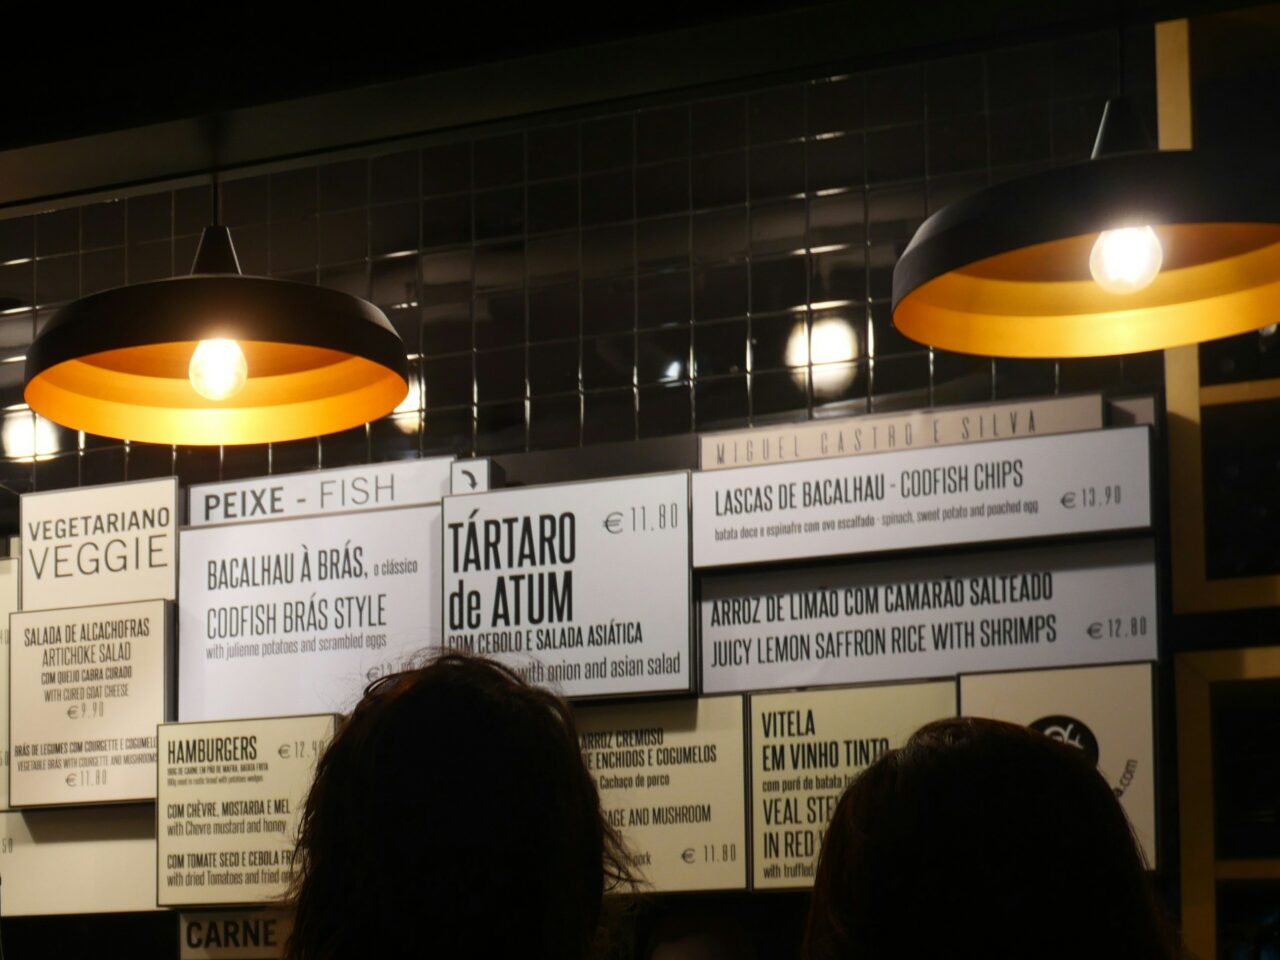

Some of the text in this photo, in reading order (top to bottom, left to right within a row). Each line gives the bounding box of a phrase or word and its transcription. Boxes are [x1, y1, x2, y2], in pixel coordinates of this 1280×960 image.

[716, 409, 1036, 465] MIGUEL CASTRO E SILVA
[205, 473, 394, 521] PEIXE FISH
[716, 459, 1023, 516] LASCAS DE BACALHAU CODFISH CHIPS
[29, 507, 169, 541] VEGETARIANO
[448, 509, 575, 573] TÁRTARO
[29, 534, 168, 580] VEGGIE
[208, 553, 294, 591] BACALHAU
[301, 544, 311, 582] À
[318, 540, 368, 581] BRÁS,
[381, 559, 417, 574] clássico
[449, 571, 573, 631] de ATUM
[711, 598, 761, 627] ARROZ
[767, 596, 785, 623] DE
[845, 587, 879, 616] COM
[885, 576, 964, 613] CAMARÃO
[970, 571, 1053, 606] SALTEADO
[207, 592, 386, 639] CODFISH BRÁS STYLE
[25, 618, 149, 647] SALADA DE ALCACHOFRAS
[206, 633, 386, 661] with julienne potatoes and scrambled eggs
[478, 631, 522, 654] CEBOLO
[527, 629, 532, 651] E
[536, 626, 584, 650] SALADA
[588, 619, 643, 647] ASIÁTICA
[711, 614, 1056, 667] JUICY LEMON SAFFRON RICE WITH SHRIMPS
[42, 642, 131, 667] ARTICHOKE SALAD
[548, 659, 580, 682] onion
[585, 655, 607, 680] and
[611, 655, 643, 677] asian
[648, 652, 680, 675] salad
[616, 728, 663, 747] CREMOSO
[762, 709, 815, 738] VITELA
[168, 736, 257, 764] HAMBURGERS
[596, 745, 716, 769] ENCHIDOS E COGUMELOS
[762, 745, 786, 771] EM
[790, 741, 838, 769] VINHO
[168, 799, 290, 819] COM CHÈVRE, MOSTARDA E MEL
[629, 804, 711, 826] AND MUSHROOM
[763, 797, 802, 825] VEAL
[168, 850, 278, 869] COM TOMATE SECO E CEBOLA
[763, 831, 814, 859] IN RED
[186, 919, 277, 948] CARNE
